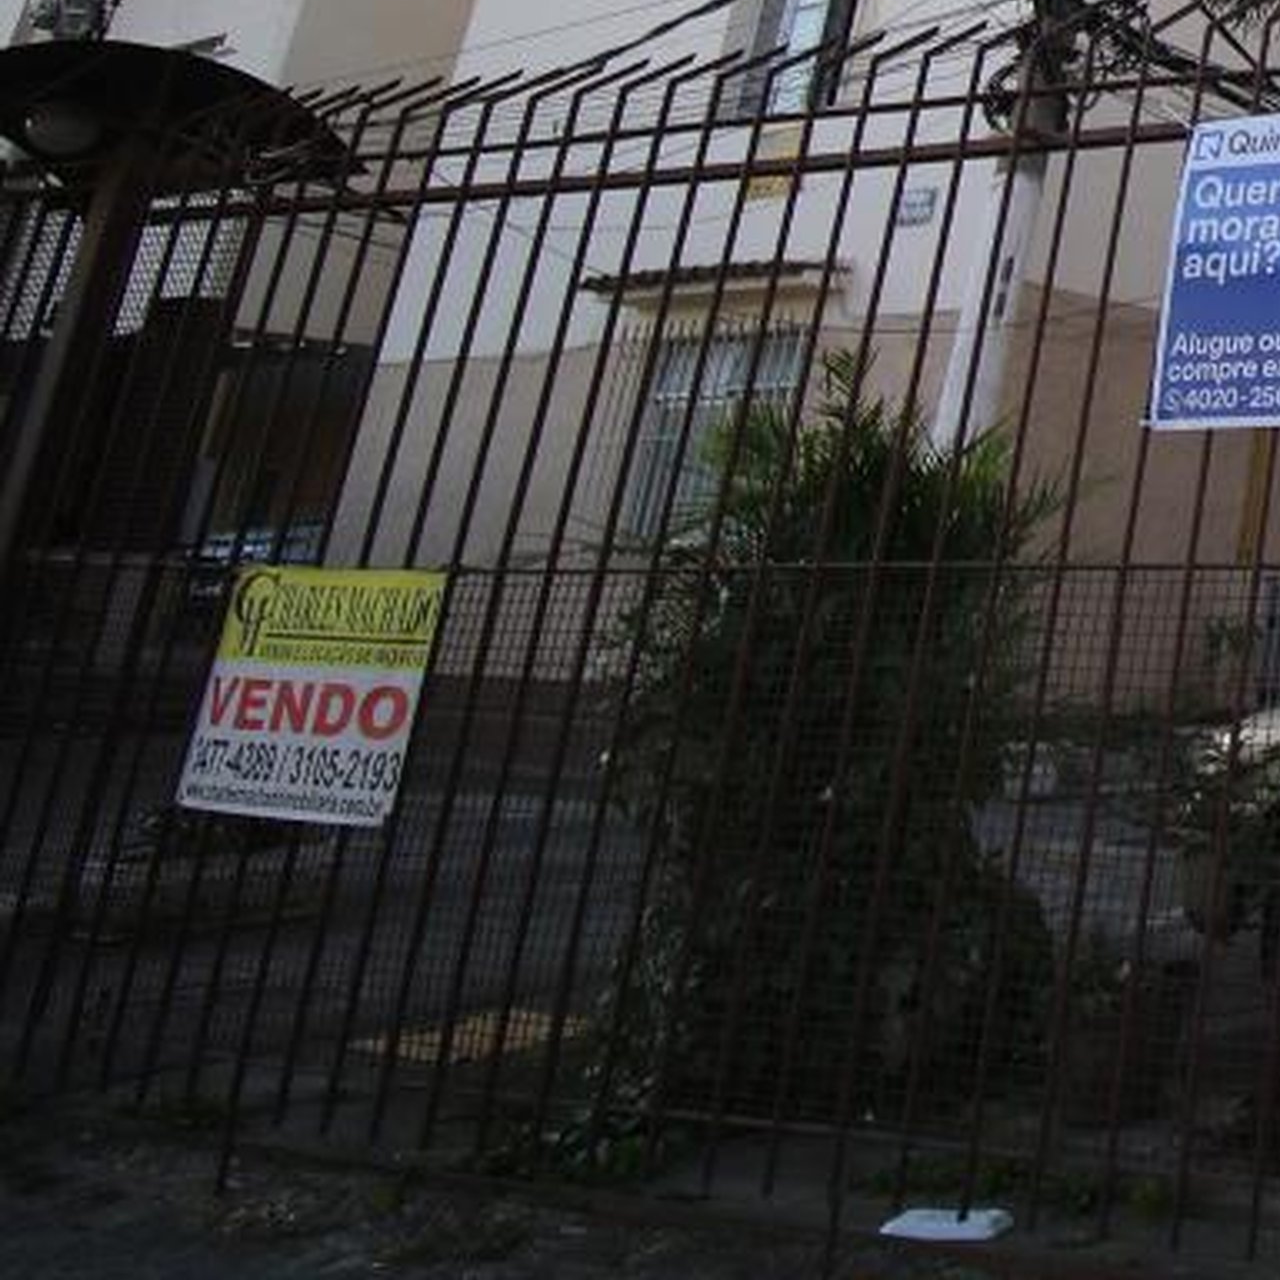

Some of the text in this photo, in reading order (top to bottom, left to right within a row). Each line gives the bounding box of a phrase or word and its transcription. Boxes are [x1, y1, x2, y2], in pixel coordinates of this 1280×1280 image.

[1172, 332, 1254, 360] Alugue
[1166, 360, 1258, 385] compre
[209, 676, 409, 740] VENDO
